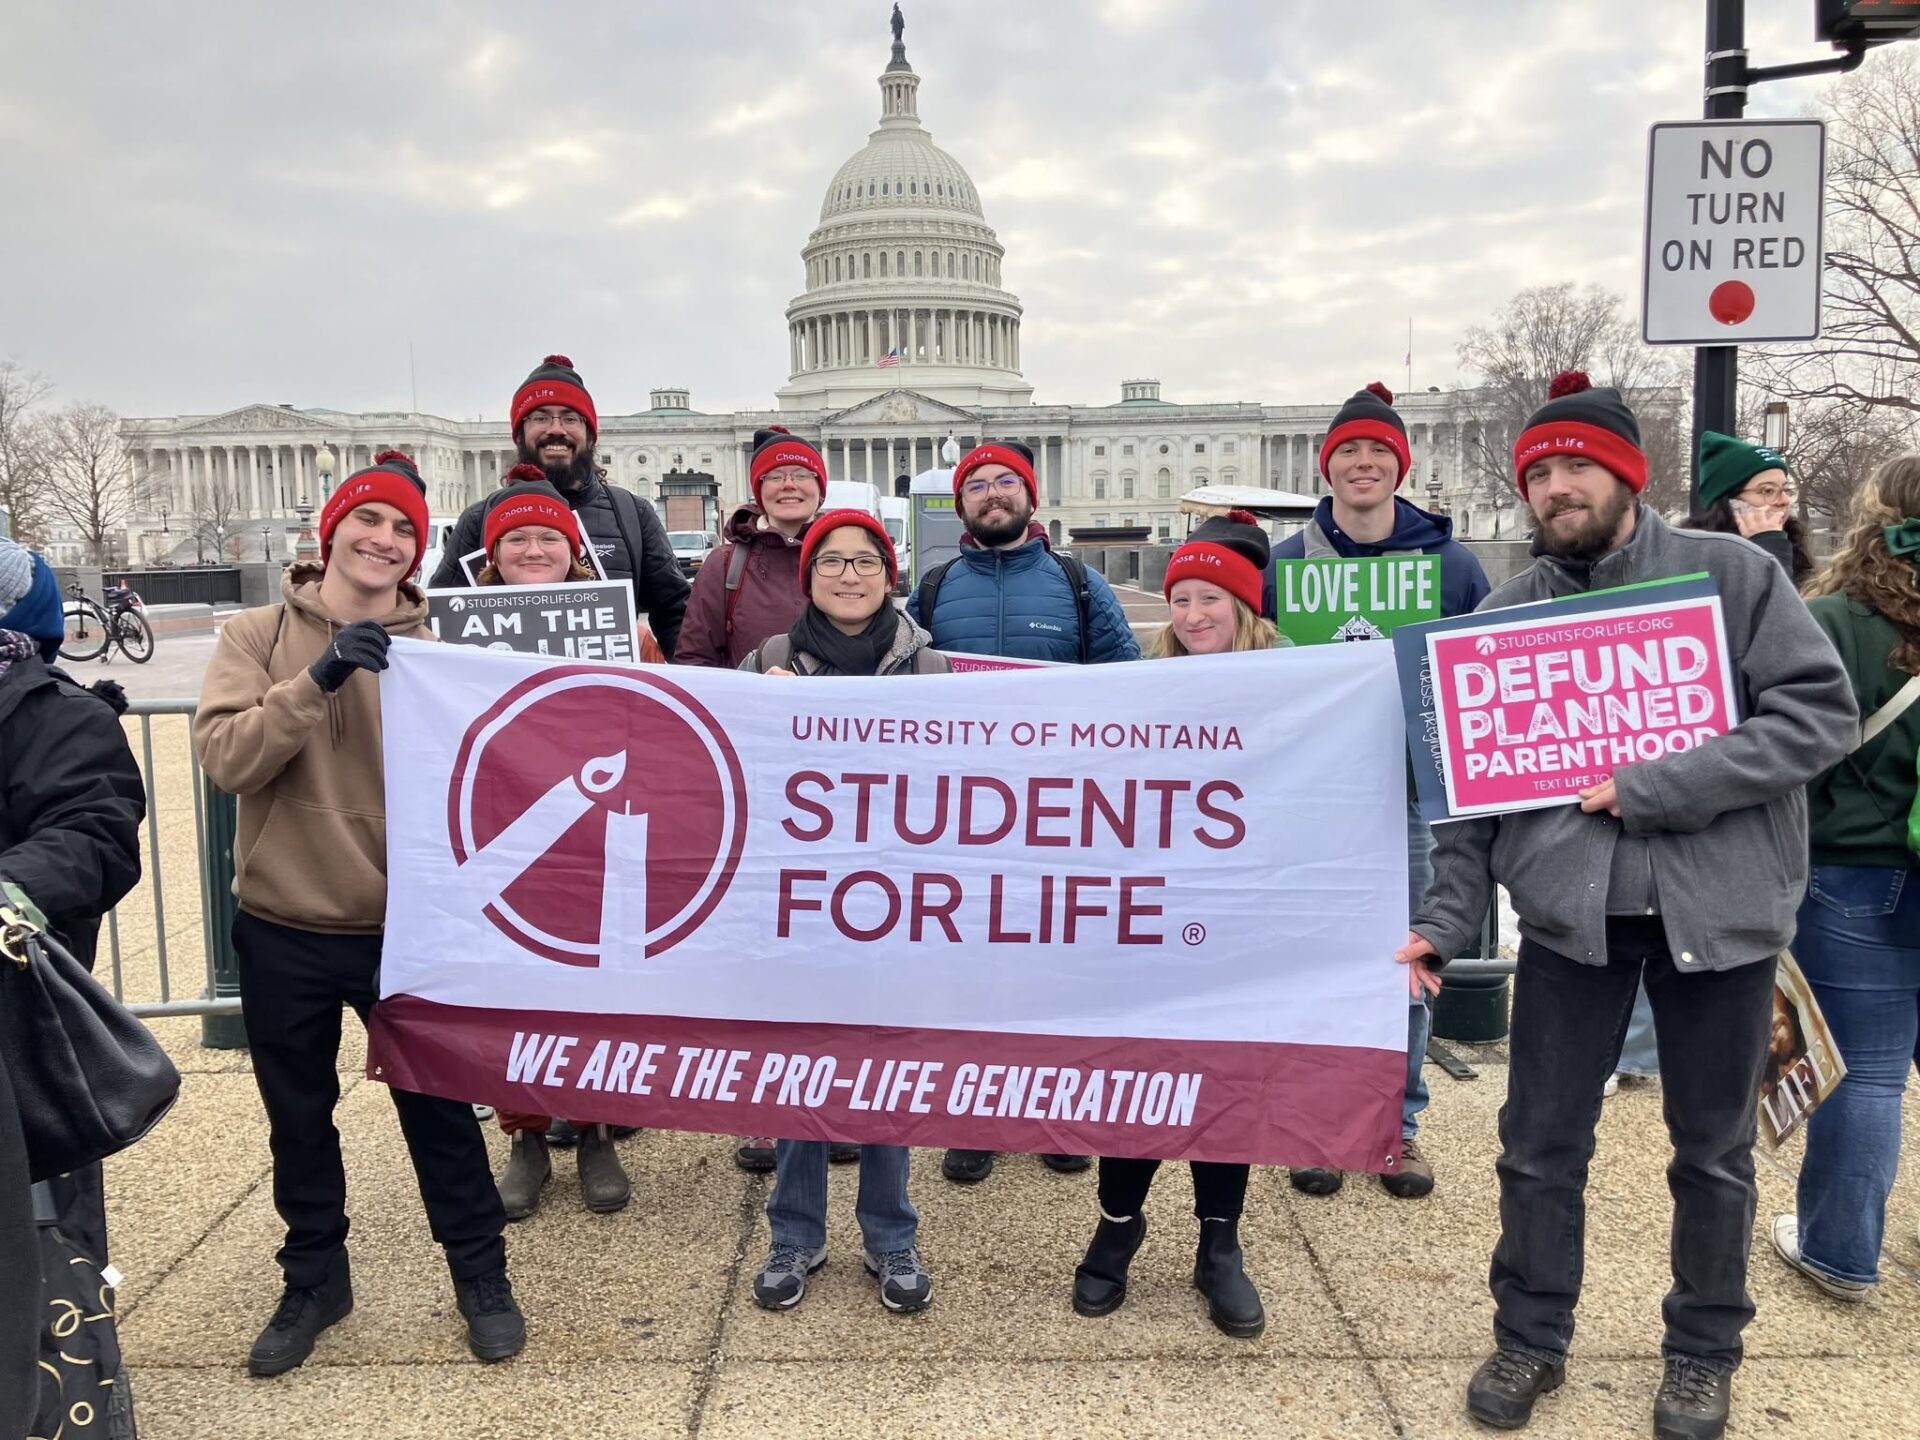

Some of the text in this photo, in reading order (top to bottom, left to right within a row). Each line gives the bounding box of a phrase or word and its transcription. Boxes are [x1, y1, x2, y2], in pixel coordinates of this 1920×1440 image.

[1700, 138, 1773, 180] NO
[1686, 191, 1785, 225] TURN
[1662, 236, 1805, 272] ON RED
[1556, 437, 1585, 449] Life
[499, 505, 534, 521] Choose
[1199, 552, 1222, 567] Life
[467, 592, 600, 609] STUDENTSFORLIFE.ORG
[1285, 560, 1433, 613] LOVE LIFE
[430, 606, 616, 639] I AM THE
[1035, 622, 1062, 632] Columbia
[1345, 626, 1353, 635] K
[1363, 626, 1371, 635] C
[1498, 616, 1674, 651] STUDENTSFORLIFE.ORG
[1453, 635, 1709, 709] DEFUND
[791, 715, 1244, 751] UNIVERSITY OF MONTANA
[1459, 684, 1715, 750] PLANNED
[1533, 773, 1610, 792] TEXT LIFE TO
[780, 769, 1247, 850] STUDENTS
[776, 868, 964, 944] FOR
[988, 873, 1166, 946] LIFE
[505, 1031, 1203, 1127] WE ARE THE PRO-LIFE GENERATION
[1761, 1038, 1836, 1139] LIFE
